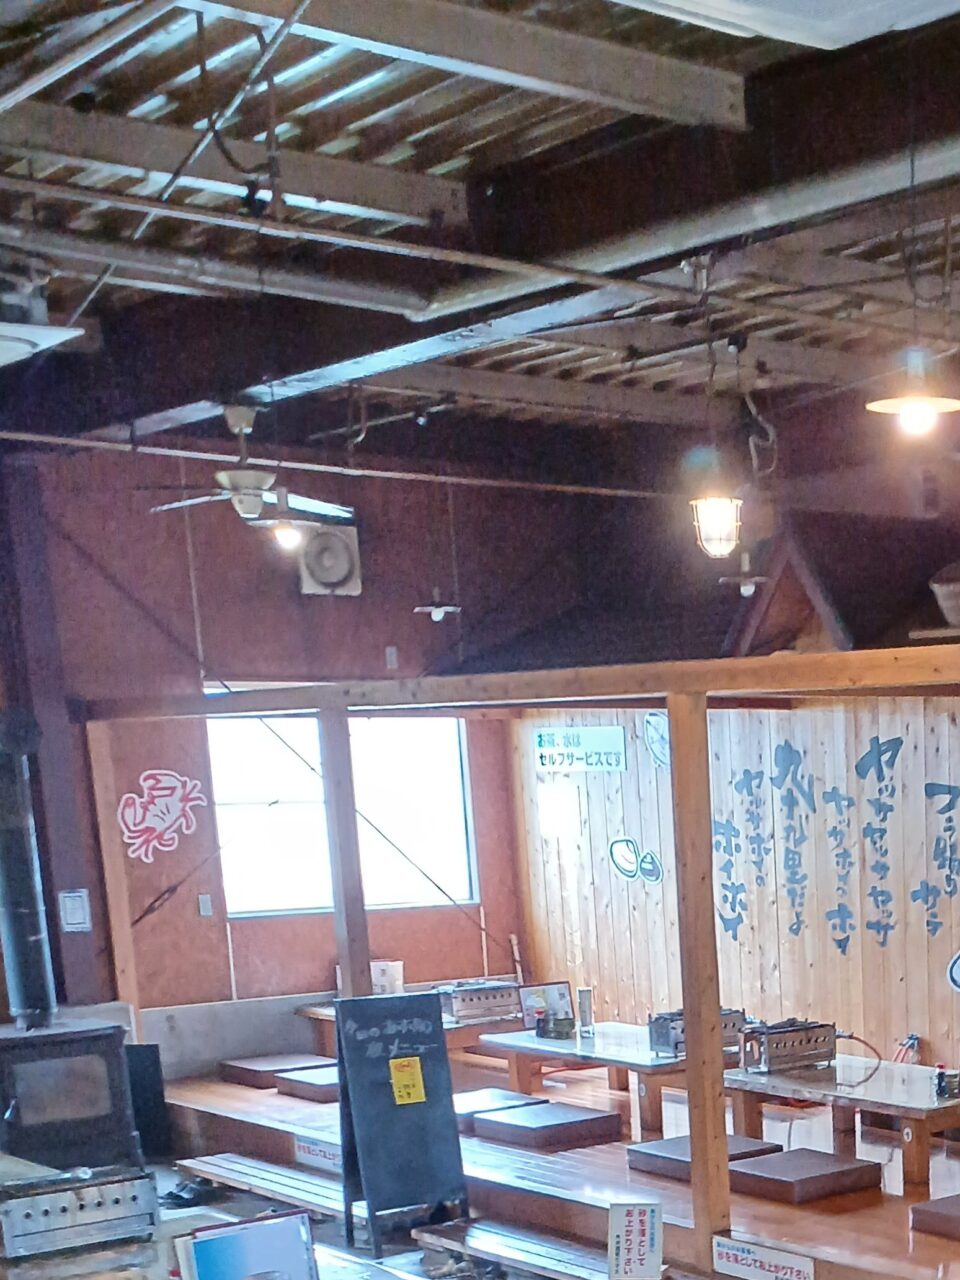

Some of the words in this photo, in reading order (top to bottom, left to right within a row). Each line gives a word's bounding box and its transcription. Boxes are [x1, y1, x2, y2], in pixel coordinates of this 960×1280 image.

[539, 751, 622, 766] セルフサービスです
